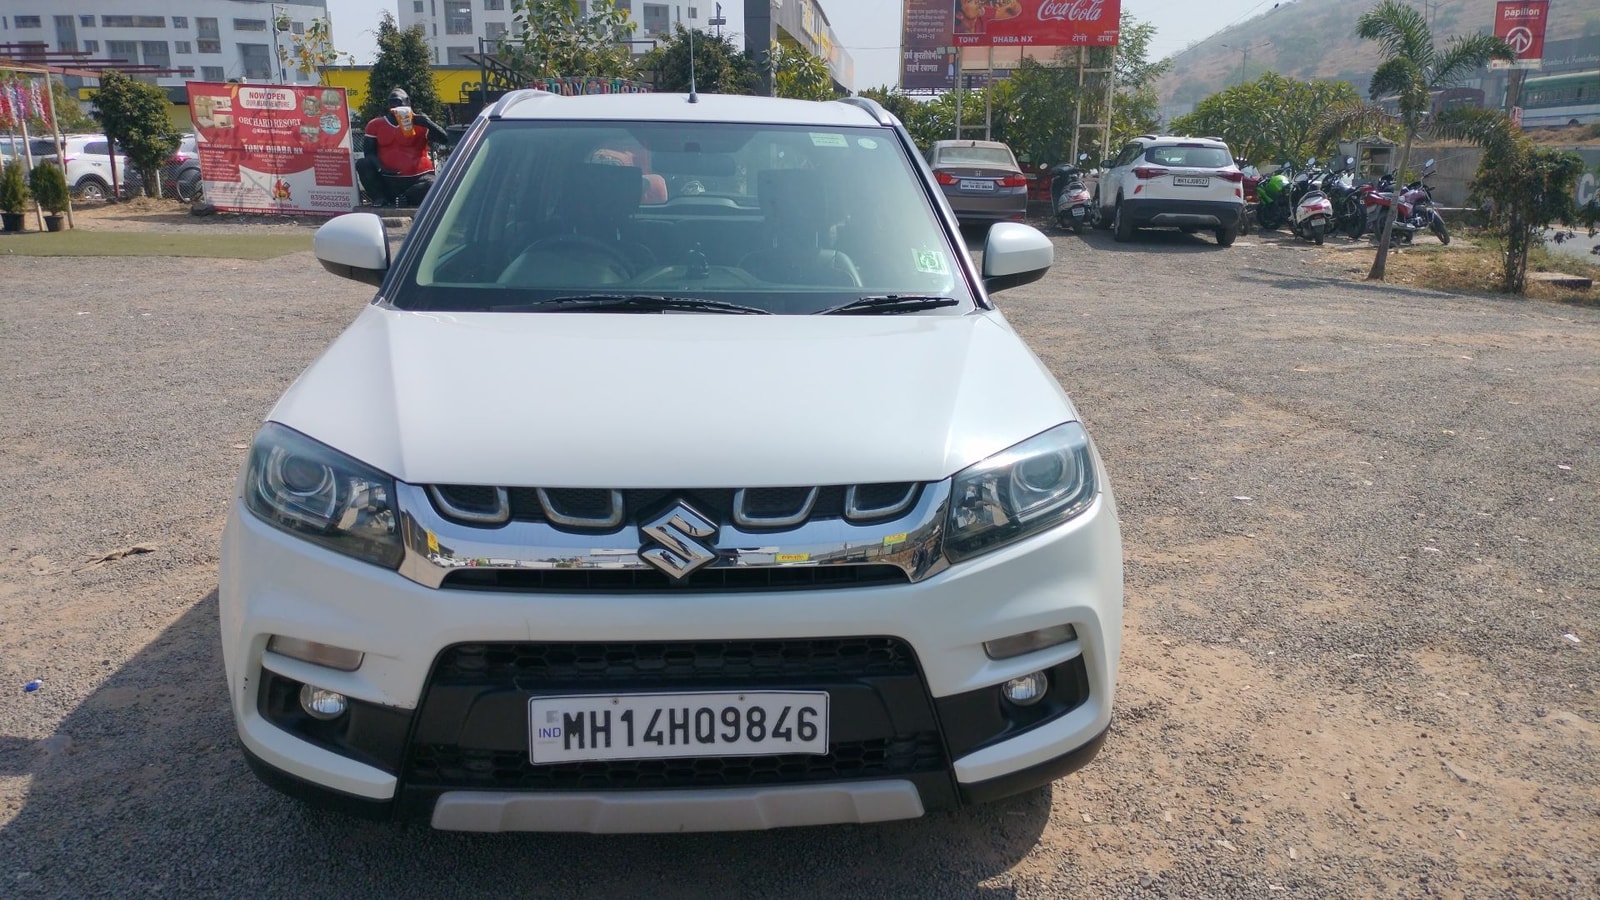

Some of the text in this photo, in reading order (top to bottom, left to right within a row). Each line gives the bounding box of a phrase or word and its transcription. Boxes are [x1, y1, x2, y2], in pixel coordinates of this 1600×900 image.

[1504, 7, 1540, 18] papillon
[1072, 33, 1088, 42] टोनी
[238, 116, 302, 128] ORCHARD RESORT
[244, 144, 264, 153] TONY
[266, 145, 292, 154] DHABA
[538, 727, 562, 739] IND
[562, 705, 819, 751] MH14HQ9846
